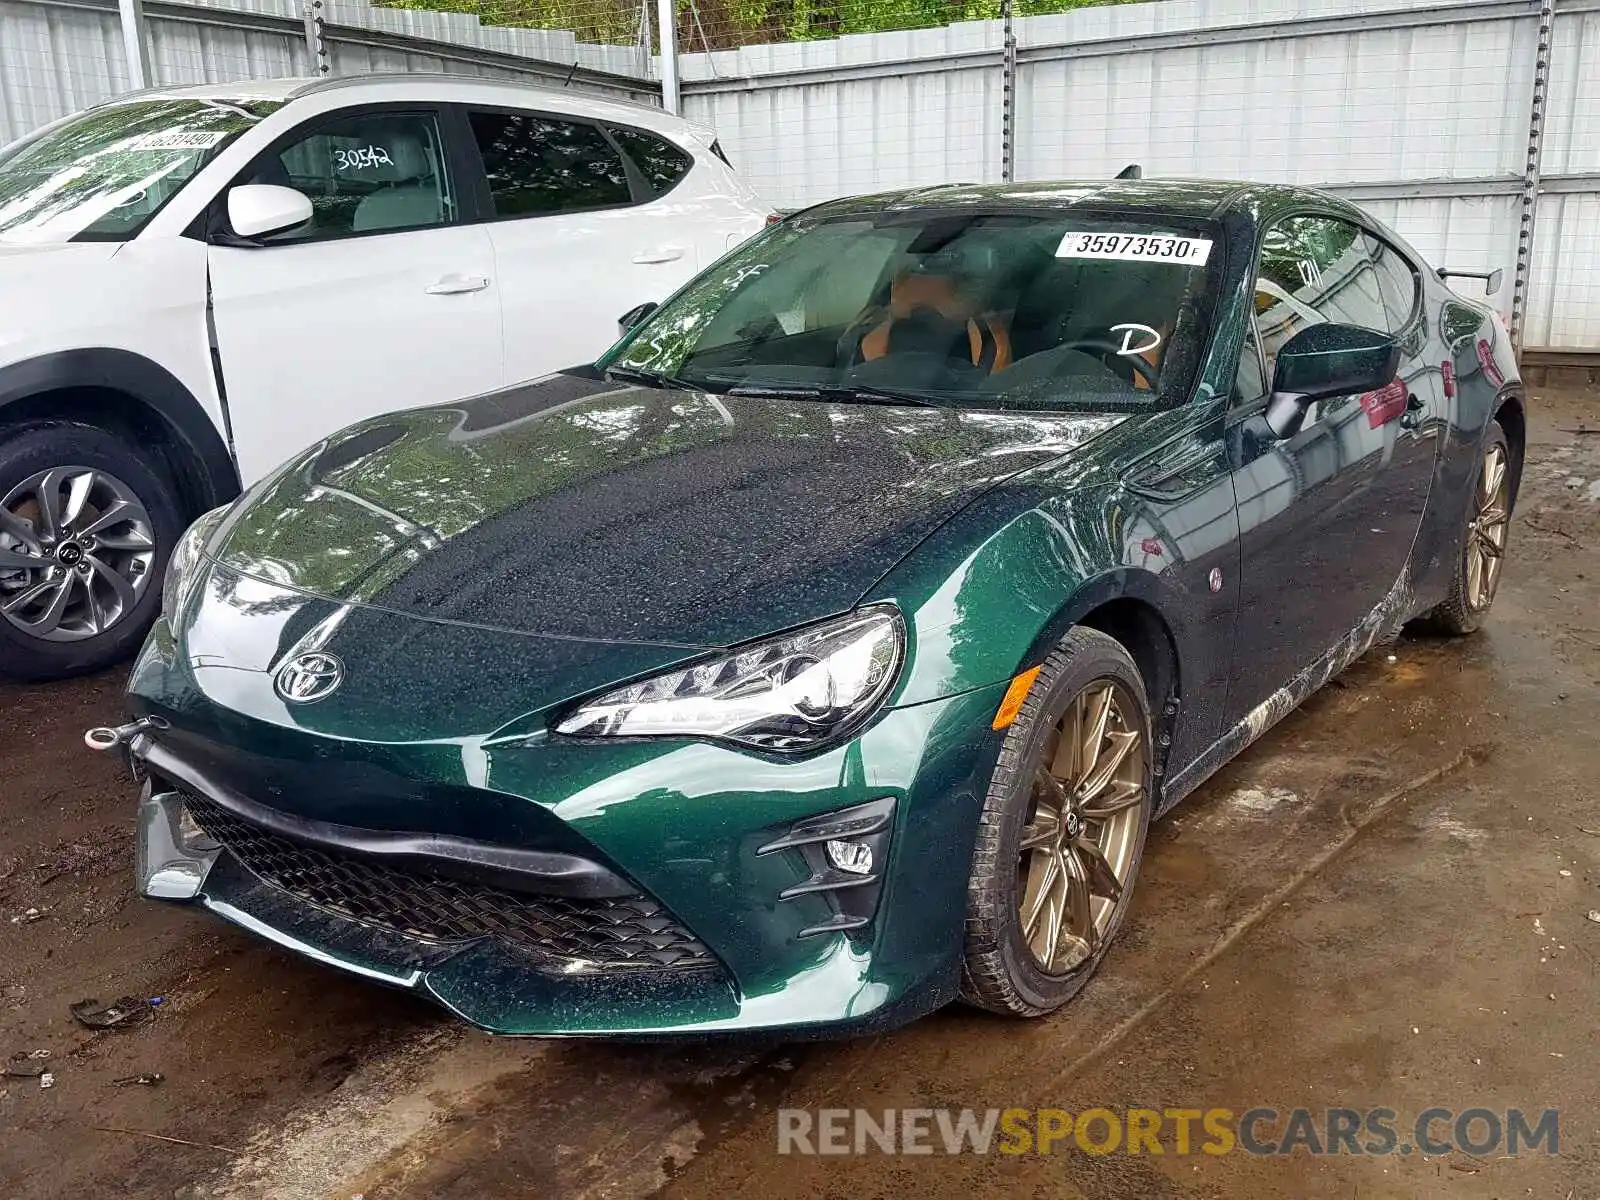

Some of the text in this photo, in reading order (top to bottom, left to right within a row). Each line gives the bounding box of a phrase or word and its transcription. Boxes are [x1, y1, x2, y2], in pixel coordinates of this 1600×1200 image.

[335, 145, 394, 170] 30,542
[1077, 235, 1191, 258] 35973530
[1192, 247, 1201, 257] F
